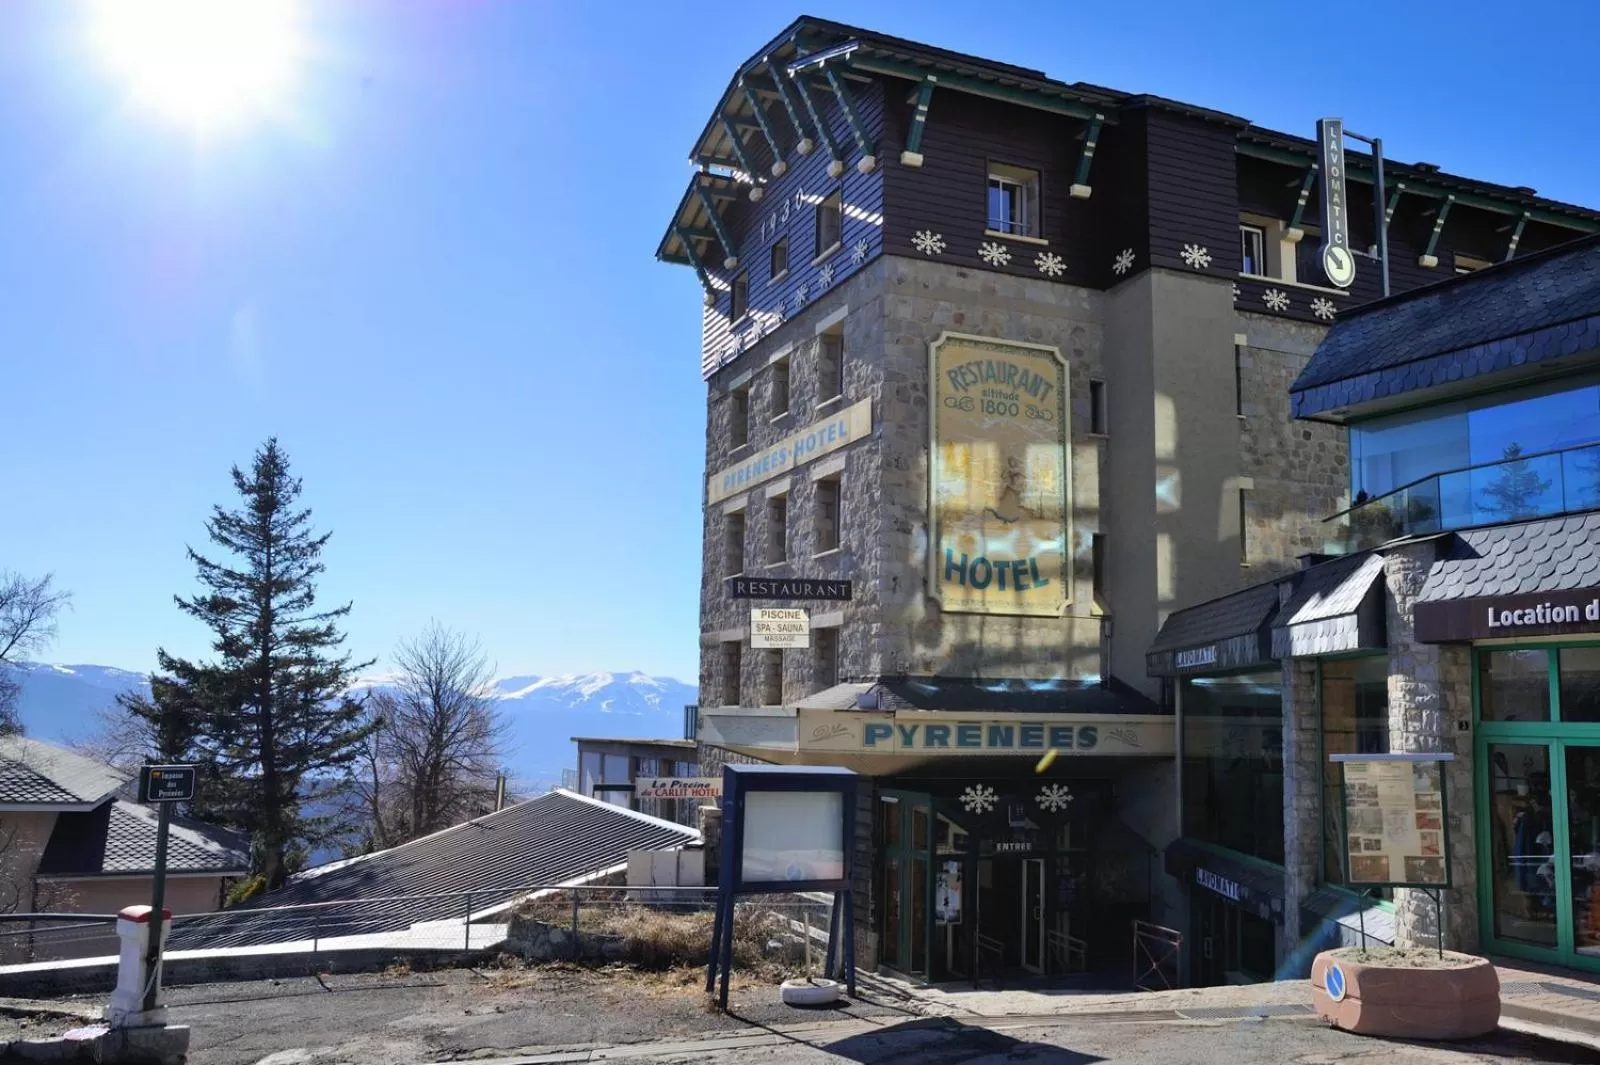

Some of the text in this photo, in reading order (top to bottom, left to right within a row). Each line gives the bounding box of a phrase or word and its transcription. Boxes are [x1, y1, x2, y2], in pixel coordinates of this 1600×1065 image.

[1329, 126, 1343, 244] LAVOMATIC
[760, 187, 804, 243] 1930
[946, 359, 1055, 403] RESTAURANT
[981, 387, 1020, 400] altitude
[980, 400, 1020, 417] 1800
[794, 419, 848, 459] HOTEL
[944, 547, 1050, 592] HOTEL
[737, 580, 849, 597] RESTAURANT
[760, 610, 802, 620] PISCINE
[1488, 602, 1580, 628] Location
[756, 623, 772, 633] SPA
[777, 623, 804, 633] SAUNA
[764, 634, 797, 642] MASSAGE
[655, 788, 687, 797] CARLIT
[691, 788, 720, 797] HOTEL
[671, 780, 711, 788] Piscine
